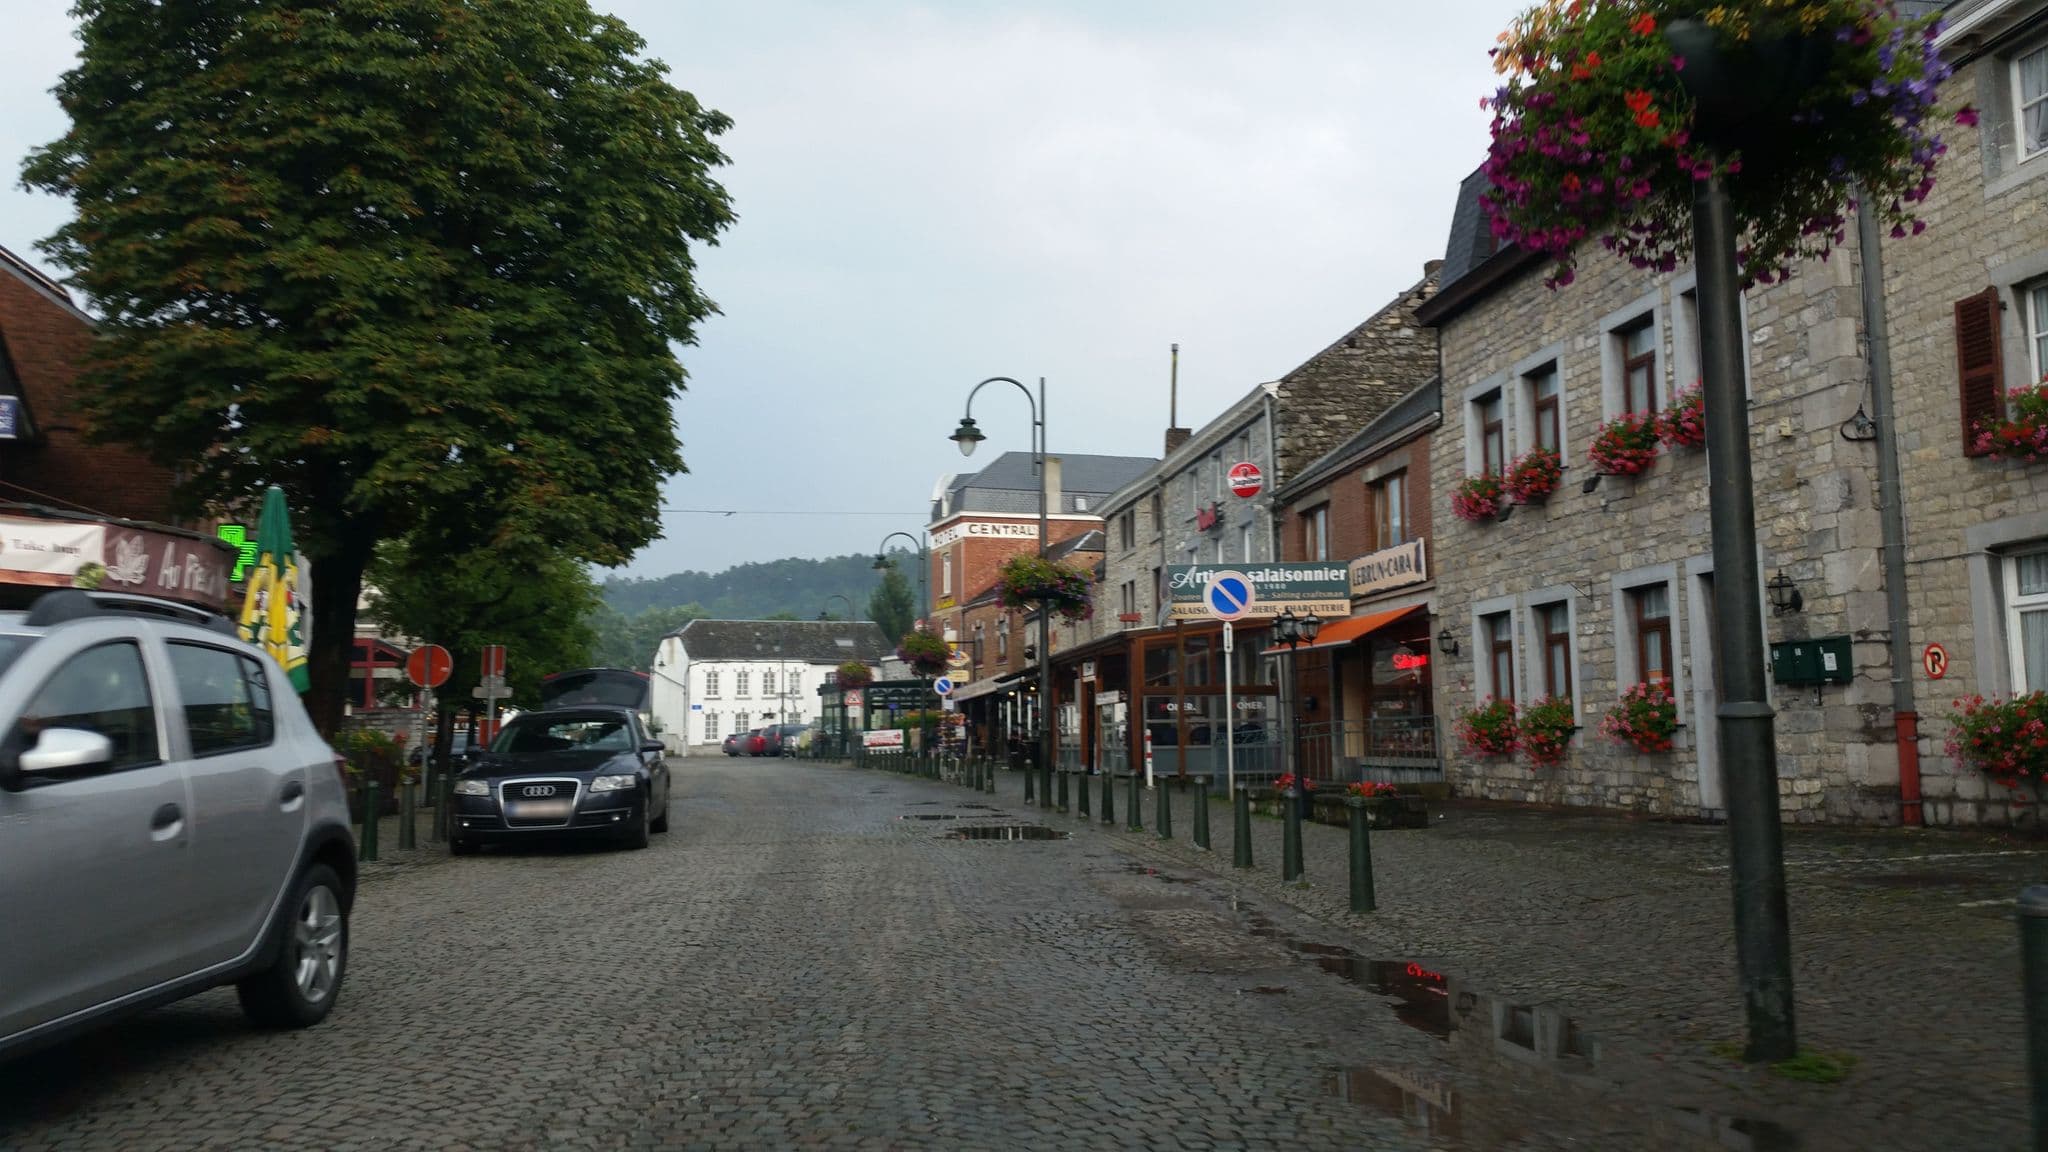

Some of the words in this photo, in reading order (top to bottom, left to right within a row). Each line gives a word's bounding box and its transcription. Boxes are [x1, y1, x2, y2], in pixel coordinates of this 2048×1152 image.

[968, 524, 1036, 536] CENTRAL
[1169, 566, 1216, 588] Arti
[1246, 567, 1347, 582] salaisonnier
[1172, 607, 1209, 615] SALAISO
